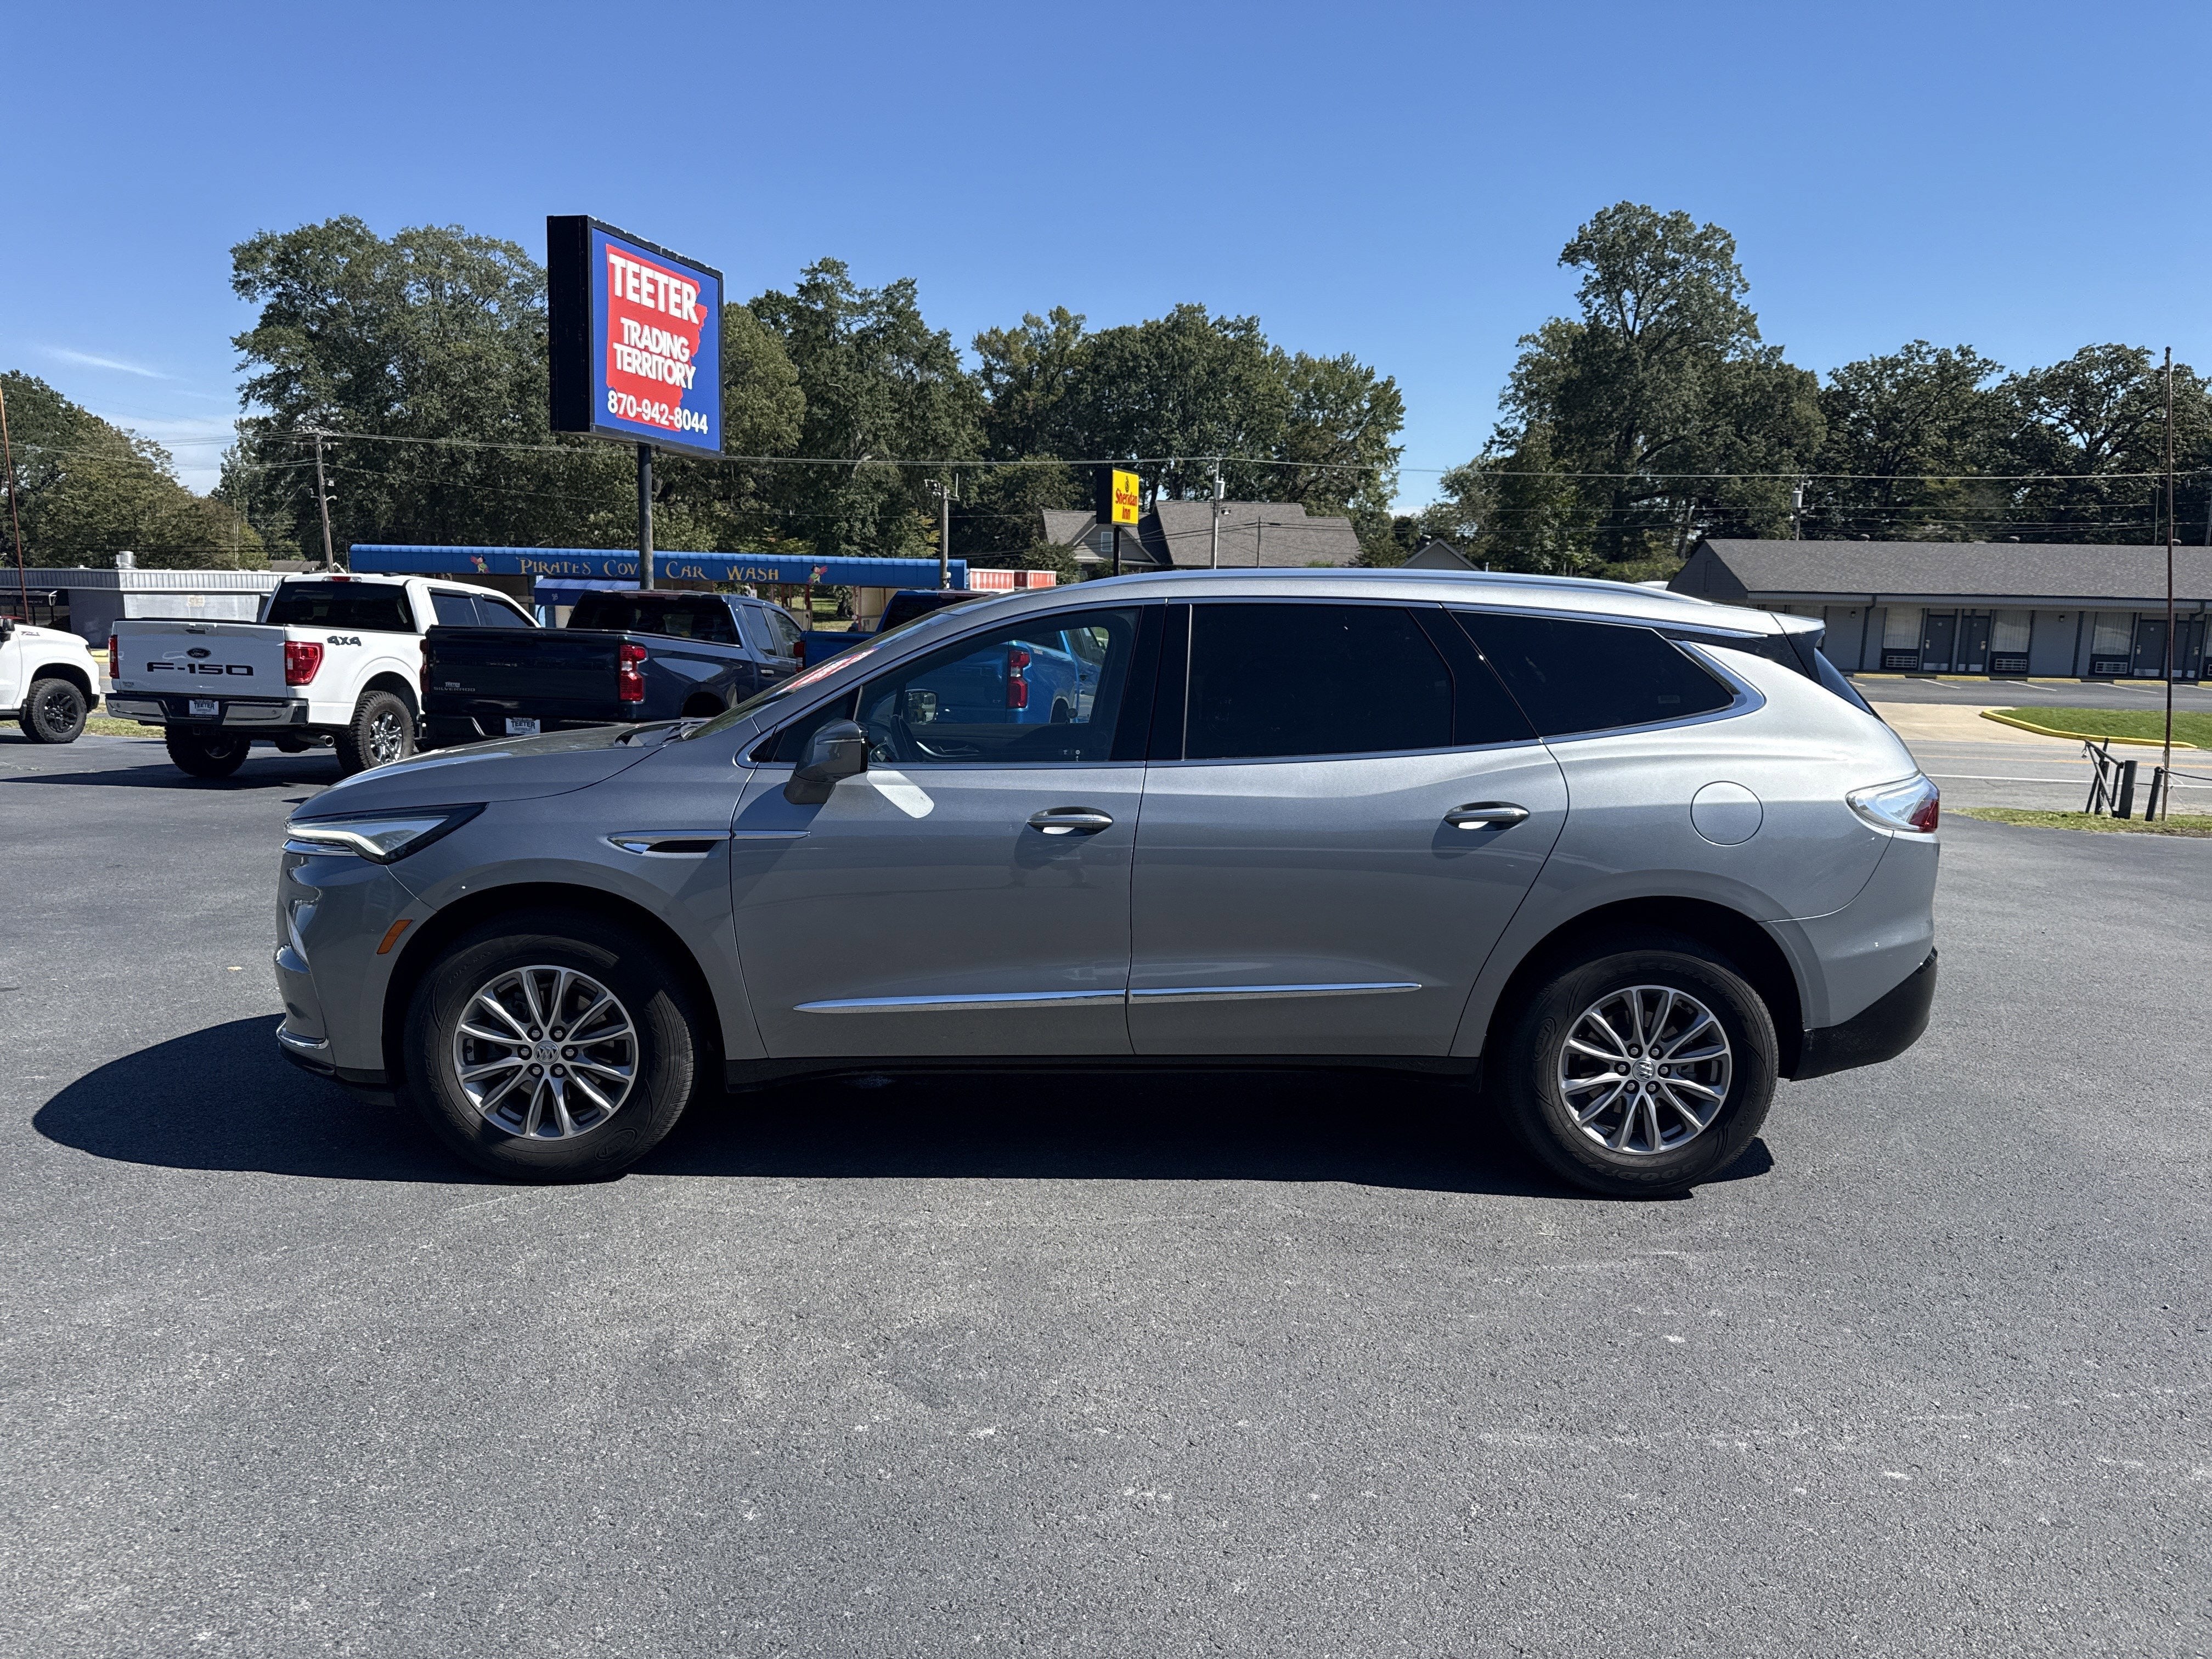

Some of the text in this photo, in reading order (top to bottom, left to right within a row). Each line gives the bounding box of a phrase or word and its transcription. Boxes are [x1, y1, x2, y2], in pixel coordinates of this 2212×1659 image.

[609, 253, 699, 325] TEETER
[620, 317, 690, 363] TRADING
[613, 343, 696, 390] TERRITORY
[607, 390, 708, 435] 870-942-8044
[1115, 488, 1137, 507] Sheridan
[1122, 506, 1130, 520] Inn
[517, 557, 778, 582] PIRATES COV CAR WASH
[146, 662, 254, 676] F-150
[194, 702, 215, 710] TEETER
[511, 720, 535, 729] TEETER
